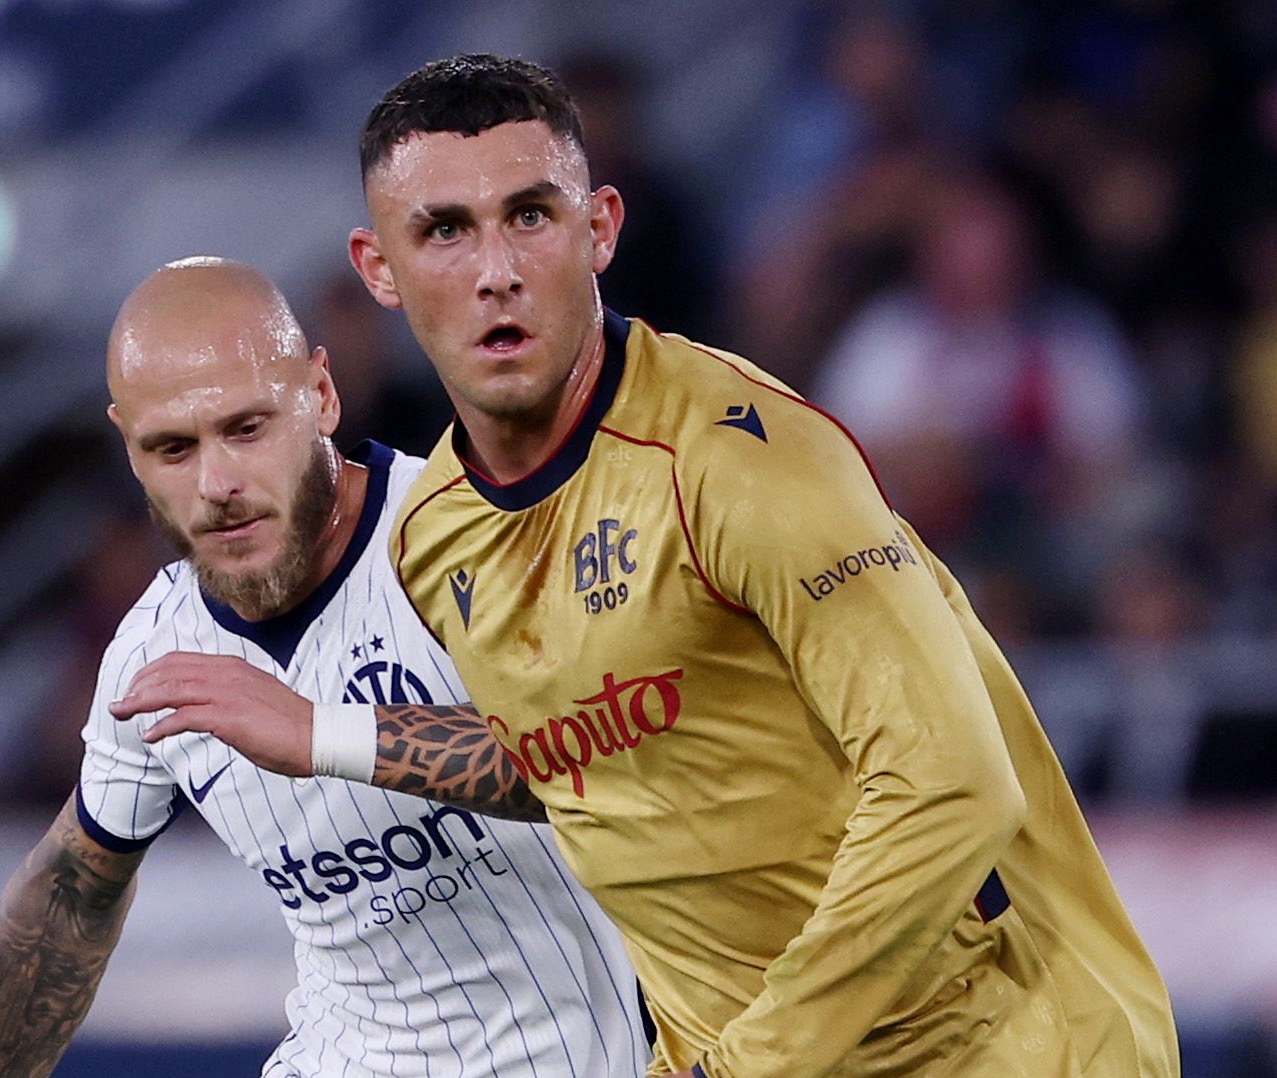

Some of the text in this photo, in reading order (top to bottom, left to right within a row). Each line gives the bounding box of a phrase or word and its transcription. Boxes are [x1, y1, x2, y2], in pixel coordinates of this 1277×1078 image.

[573, 518, 638, 593] BFC
[584, 582, 629, 614] 1909
[486, 668, 684, 799] Saputo
[263, 806, 486, 910] etsson
